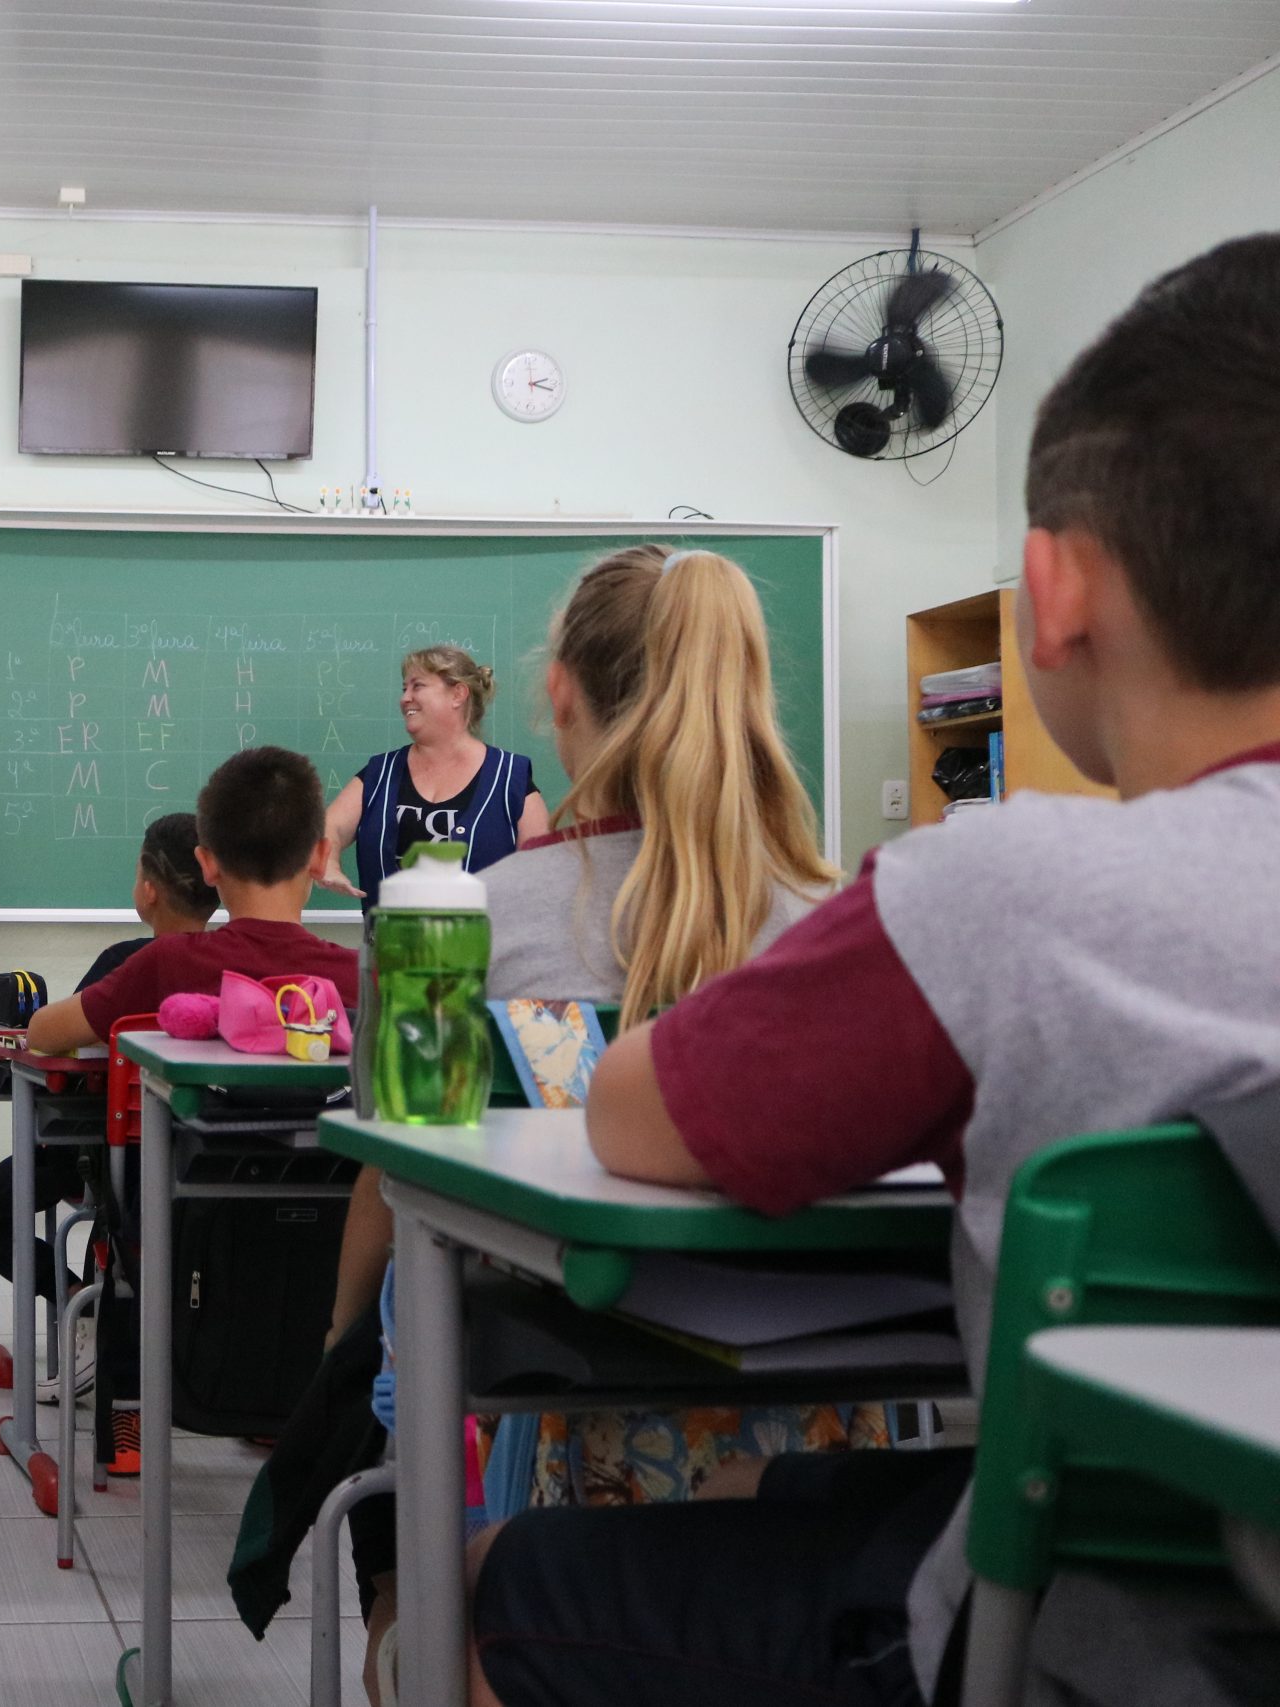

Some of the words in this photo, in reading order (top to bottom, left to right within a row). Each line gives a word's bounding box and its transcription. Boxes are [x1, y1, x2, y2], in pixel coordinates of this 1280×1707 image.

[67, 655, 86, 681] P
[142, 659, 170, 688] M
[236, 656, 255, 686] H
[70, 691, 87, 718] P
[147, 693, 171, 718] M
[235, 691, 252, 715] H
[322, 720, 345, 752] A
[66, 759, 101, 796] M
[145, 760, 170, 790] C
[72, 803, 98, 837] M
